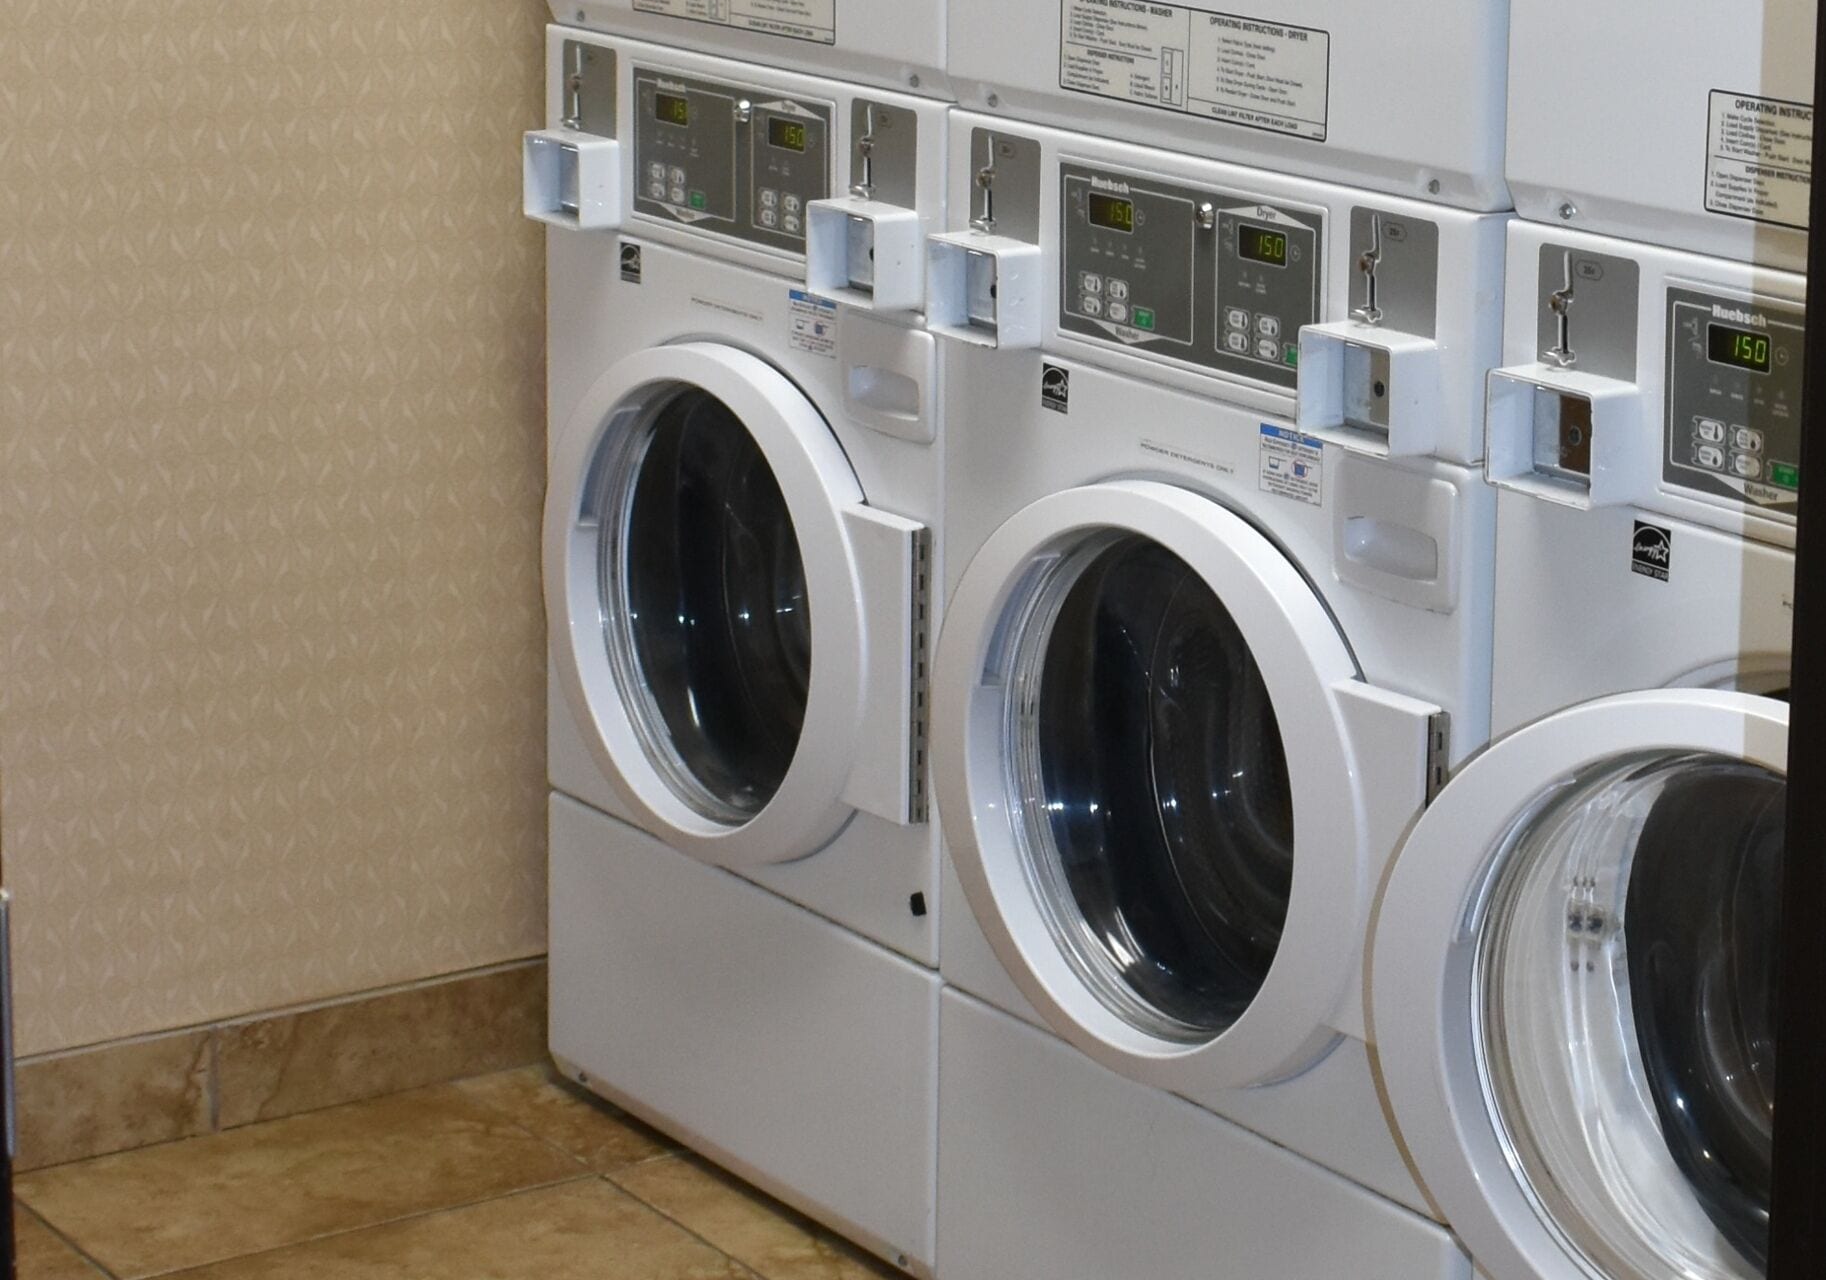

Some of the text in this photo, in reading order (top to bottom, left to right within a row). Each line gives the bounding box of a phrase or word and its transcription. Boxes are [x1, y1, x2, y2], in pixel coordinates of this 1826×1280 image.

[1109, 0, 1146, 13] INSTRUCTIONS
[1150, 6, 1172, 18] WASHER
[1210, 16, 1241, 30] OPERATING
[1243, 22, 1284, 38] INSTRUCTIONS
[1288, 30, 1308, 41] DRYER
[1735, 99, 1812, 121] OPERATING INSTRUC
[1239, 111, 1254, 121] FILTER
[1255, 114, 1270, 124] AFTER
[1284, 120, 1298, 130] LOAD
[1091, 175, 1129, 194] Huebsch
[1256, 206, 1276, 221] Dryer
[1258, 235, 1284, 258] 150
[1712, 304, 1767, 328] Huebsch
[1115, 325, 1140, 341] Washer
[1734, 334, 1767, 363] 150
[1278, 430, 1304, 442] NOTICE
[1140, 443, 1169, 455] POWDER
[1170, 452, 1214, 468] DETERGENTS
[1743, 482, 1779, 501] Washer
